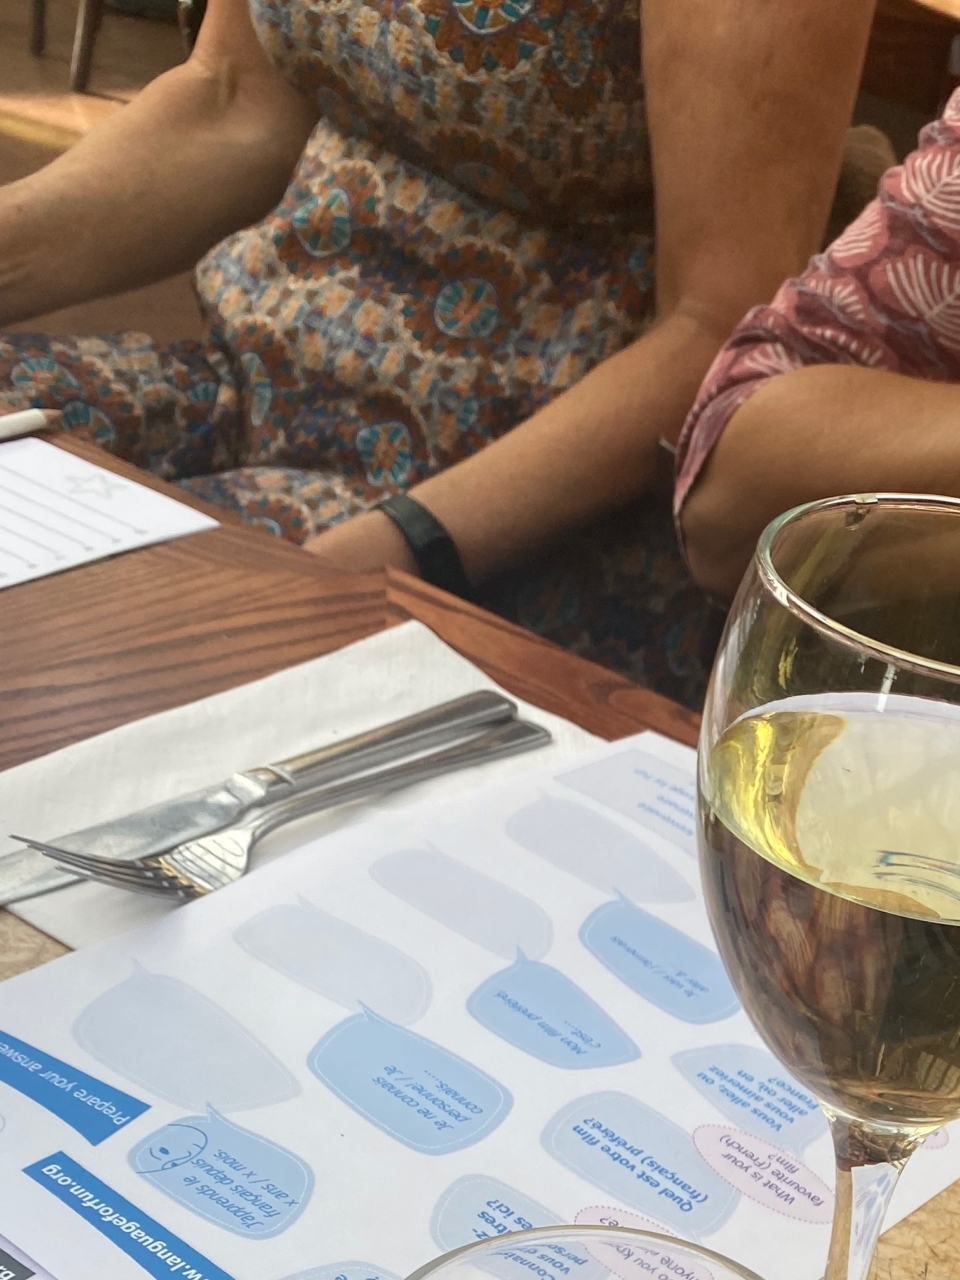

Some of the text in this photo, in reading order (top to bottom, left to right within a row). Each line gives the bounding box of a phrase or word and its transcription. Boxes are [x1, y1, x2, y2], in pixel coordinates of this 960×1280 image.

[0, 1041, 131, 1125] Prepare your answe
[383, 1065, 404, 1076] Je
[736, 1069, 756, 1083] en
[371, 1075, 455, 1131] Je ne connais
[403, 1082, 473, 1123] personne!
[696, 1072, 783, 1132] Vous allez, ou
[709, 1064, 796, 1124] vous aimeriez
[767, 1076, 820, 1111] France?
[776, 1095, 809, 1117] aller
[213, 1149, 248, 1172] mois.
[572, 1124, 693, 1213] Quel est votre film
[582, 1116, 710, 1205] (français) préféré?
[718, 1134, 825, 1208] favourite (French)
[721, 1152, 797, 1207] What is your
[767, 1153, 801, 1175] film?
[182, 1175, 265, 1229] J'apprends le
[190, 1158, 282, 1219] français depuis
[260, 1183, 290, 1200] ans
[486, 1199, 515, 1220] ici?
[537, 1252, 572, 1276] vous
[632, 1255, 657, 1277] you
